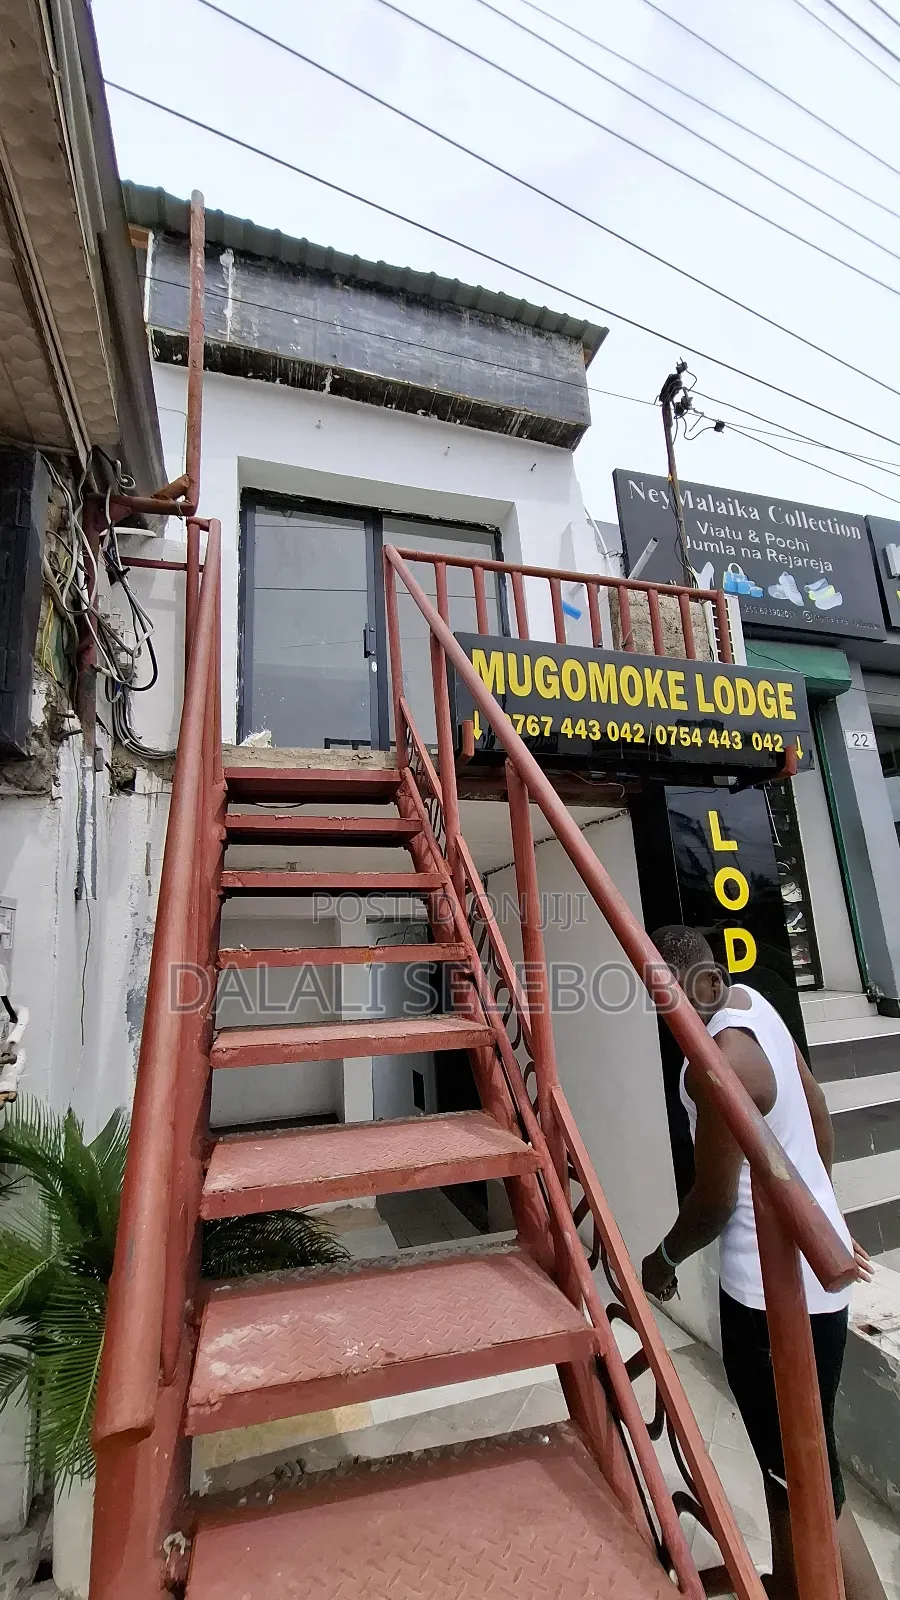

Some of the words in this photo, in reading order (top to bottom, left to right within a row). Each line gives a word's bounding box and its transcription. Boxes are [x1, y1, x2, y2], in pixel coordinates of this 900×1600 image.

[627, 479, 671, 509] Ney
[679, 489, 762, 521] Malaika
[768, 505, 862, 540] Collection
[696, 520, 742, 541] Viatu
[748, 529, 761, 543] &
[765, 531, 810, 552] Pochi
[741, 546, 762, 560] na
[767, 548, 834, 573] Rejareja
[472, 648, 689, 711] MUGOMOKE
[696, 673, 797, 720] LODGE
[560, 717, 601, 741] 443
[708, 731, 742, 750] 443
[752, 732, 785, 752] 042
[851, 733, 870, 748] 22
